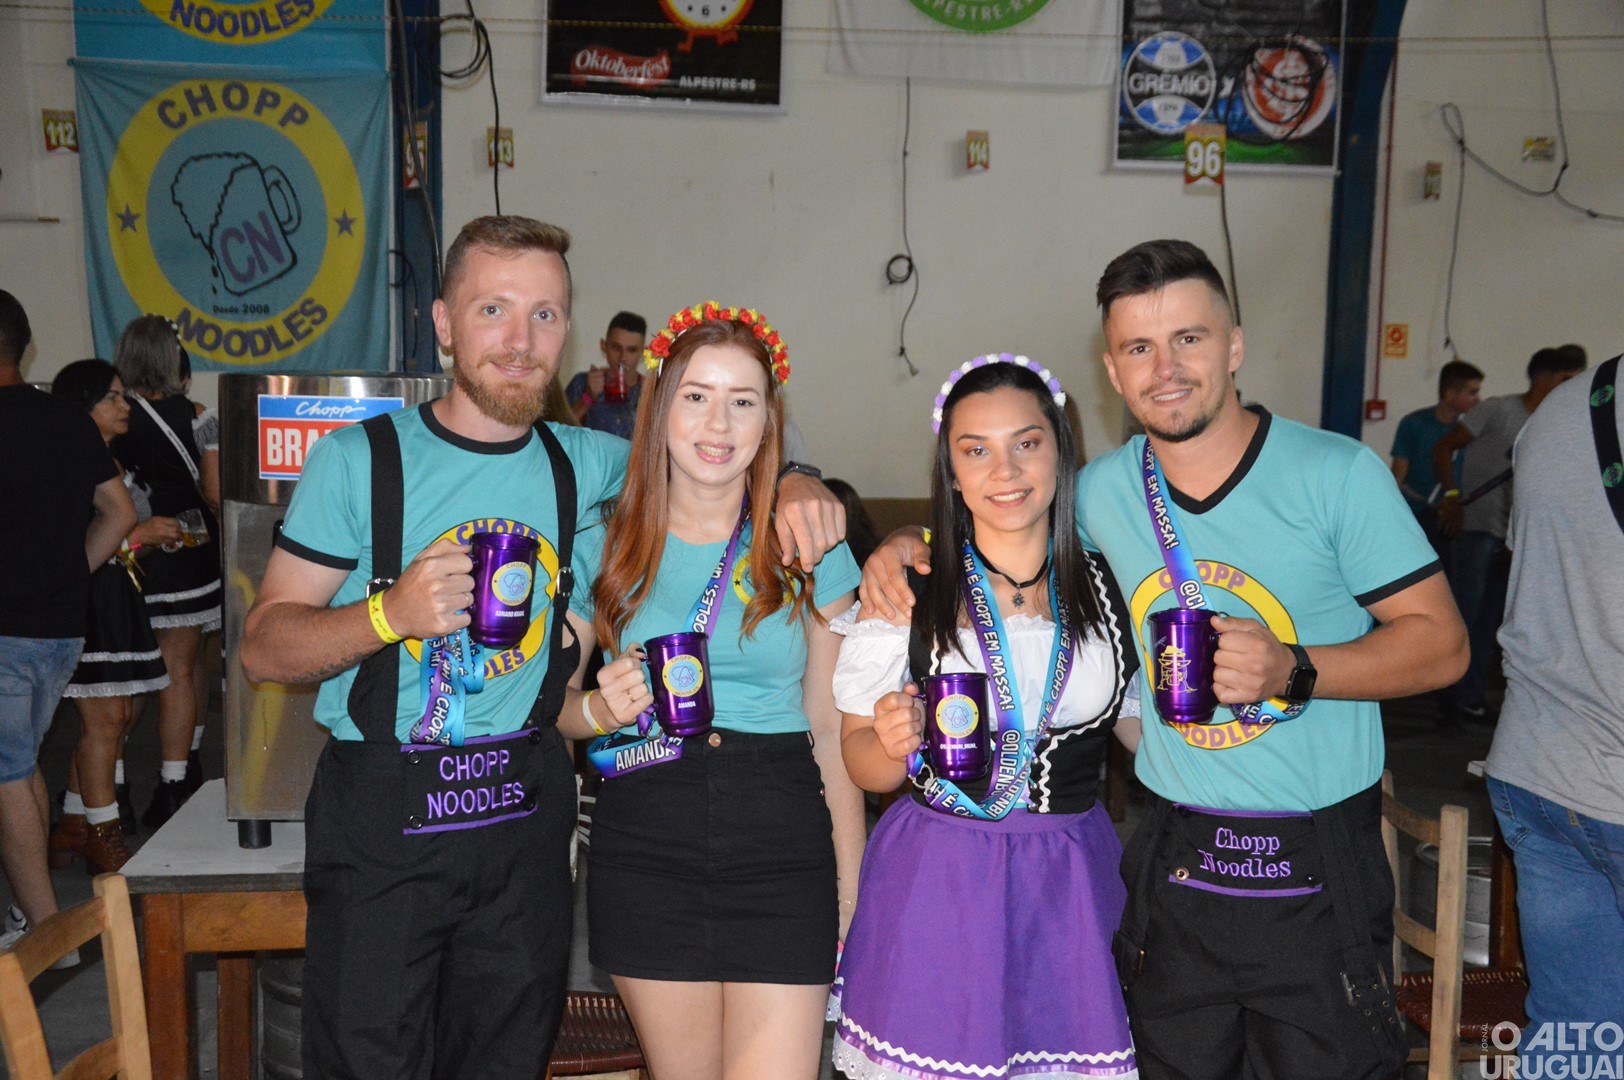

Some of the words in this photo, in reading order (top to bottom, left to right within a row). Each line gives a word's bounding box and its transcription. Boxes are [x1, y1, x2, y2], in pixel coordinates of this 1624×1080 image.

[170, 0, 315, 38] NOODLES
[575, 49, 669, 83] Oktoberfest
[679, 75, 756, 91] ALPESTRE-RS
[157, 81, 309, 129] CHOPP
[48, 120, 76, 146] 112
[1187, 140, 1221, 178] 96
[220, 209, 286, 284] CN
[242, 303, 270, 314] 2008
[175, 297, 328, 358] NOODLES
[295, 400, 367, 417] Chopp
[1152, 496, 1180, 550] MASSA!
[1158, 561, 1246, 590] COPP
[970, 586, 994, 628] CHOPP
[983, 630, 1001, 652] EM
[989, 654, 1016, 711] MASSA!
[1050, 650, 1070, 700] CHOPP
[440, 749, 510, 781] CHOPP
[427, 781, 525, 819] NOODLES
[1215, 827, 1281, 855] Chopp
[1197, 849, 1291, 878] Noodles
